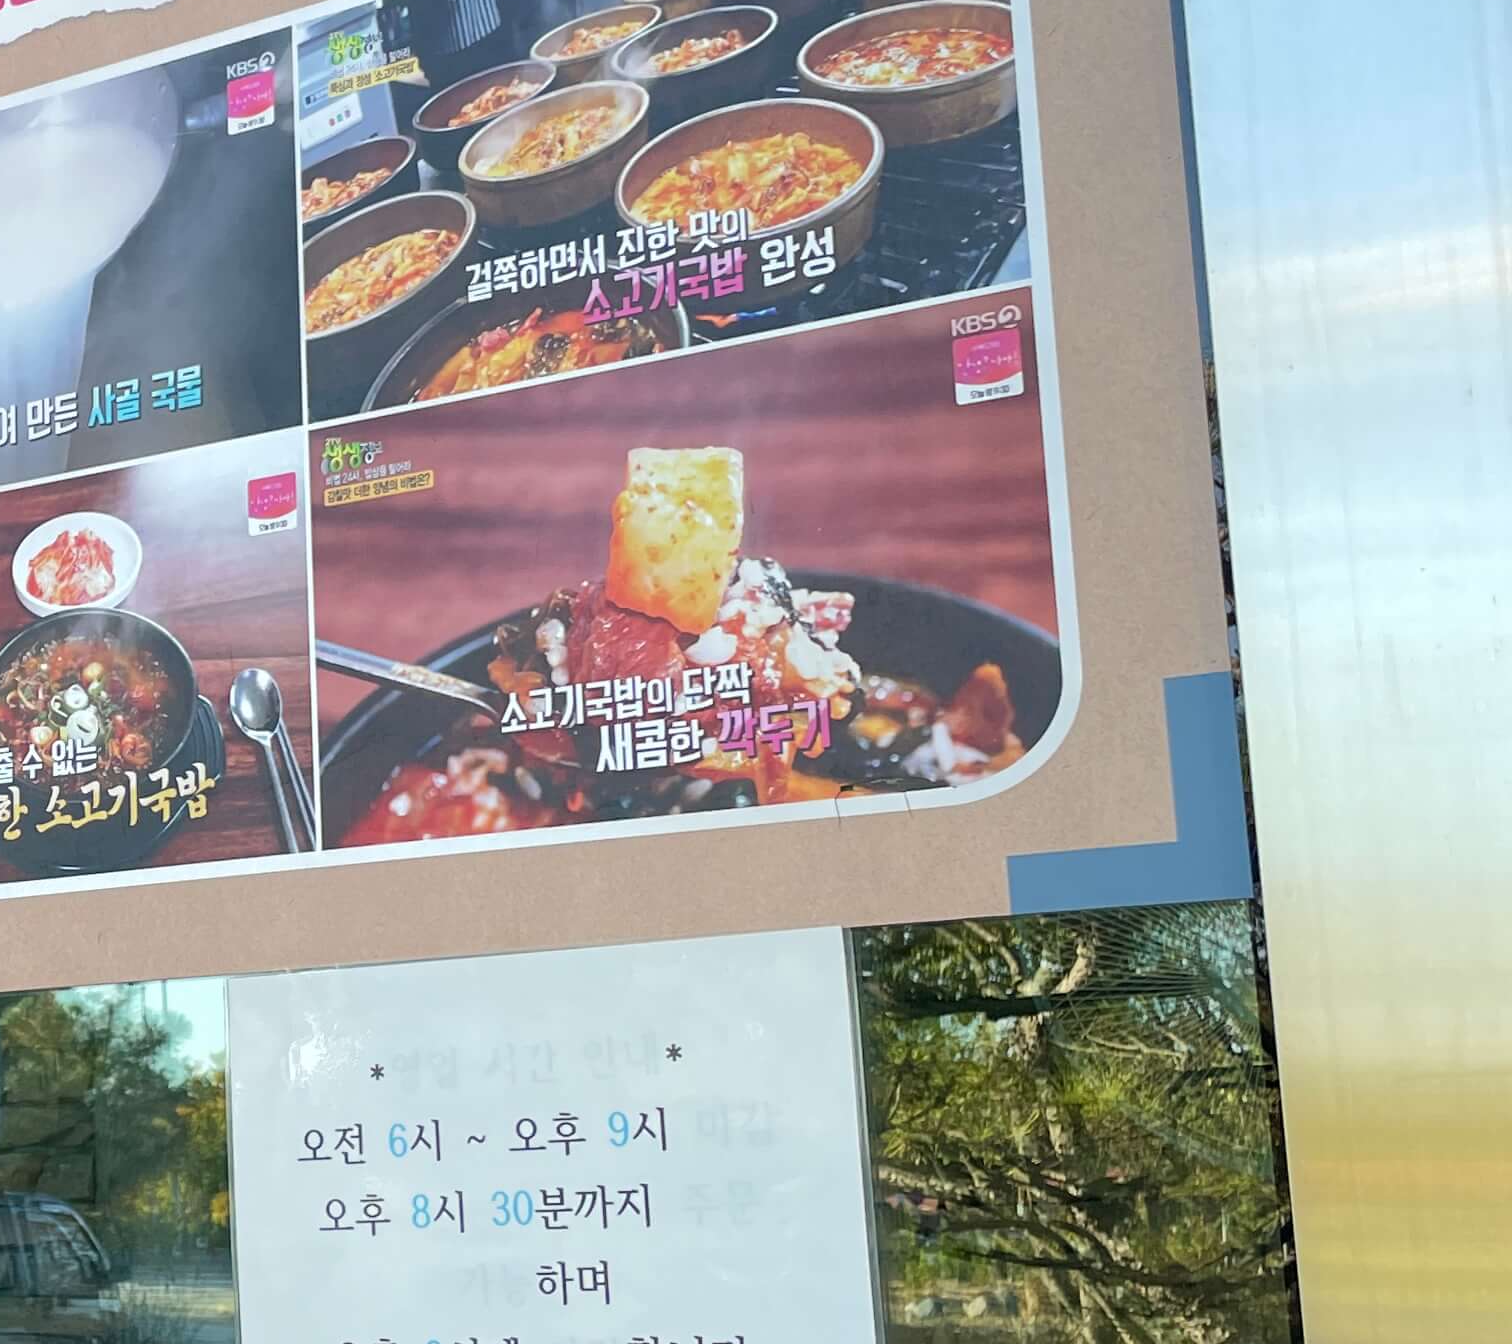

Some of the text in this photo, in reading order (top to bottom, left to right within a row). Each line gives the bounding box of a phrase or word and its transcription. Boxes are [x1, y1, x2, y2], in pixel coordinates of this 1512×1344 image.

[464, 205, 751, 304] 걸쭉하면서 진한 맛의
[581, 225, 837, 327] 소고기국밥 완성
[26, 391, 80, 436] 만든
[86, 377, 142, 428] 사골
[151, 362, 205, 412] 국물
[499, 661, 754, 735] 소고기국밥의 단짝
[21, 750, 45, 779] 수
[51, 740, 99, 777] 없는
[594, 696, 834, 775] 새콤한 깍두기
[34, 762, 216, 835] 소고기국밥
[296, 1106, 670, 1166] 오전 6시 오후 9시
[318, 1182, 654, 1238] 오후 8시 30분까지
[535, 1258, 614, 1307] 하며
